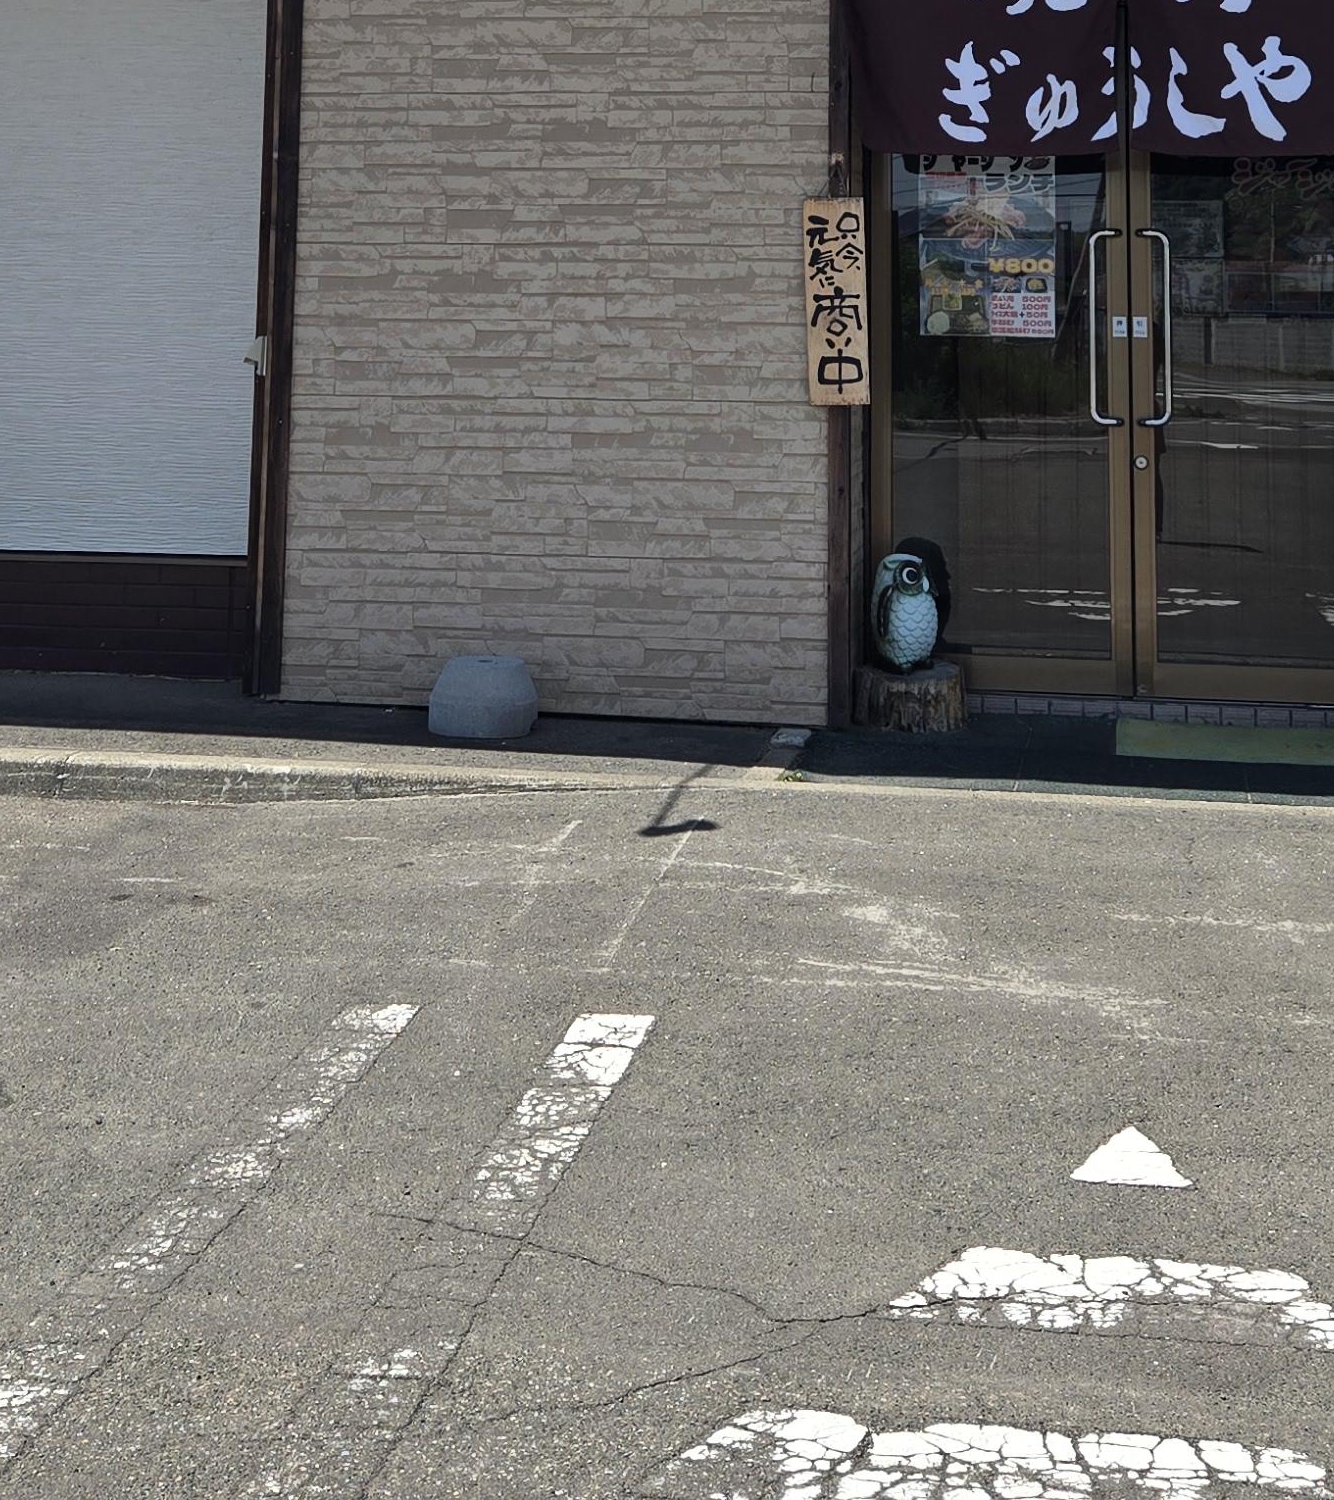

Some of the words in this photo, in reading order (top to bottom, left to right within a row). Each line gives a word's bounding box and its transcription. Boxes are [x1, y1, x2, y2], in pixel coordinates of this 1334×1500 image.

[938, 35, 1313, 143] ぎゅうしや
[985, 173, 1054, 192] ランチ
[805, 214, 843, 289] 元気に
[988, 257, 1055, 274] ¥800
[810, 285, 864, 395] 商い中
